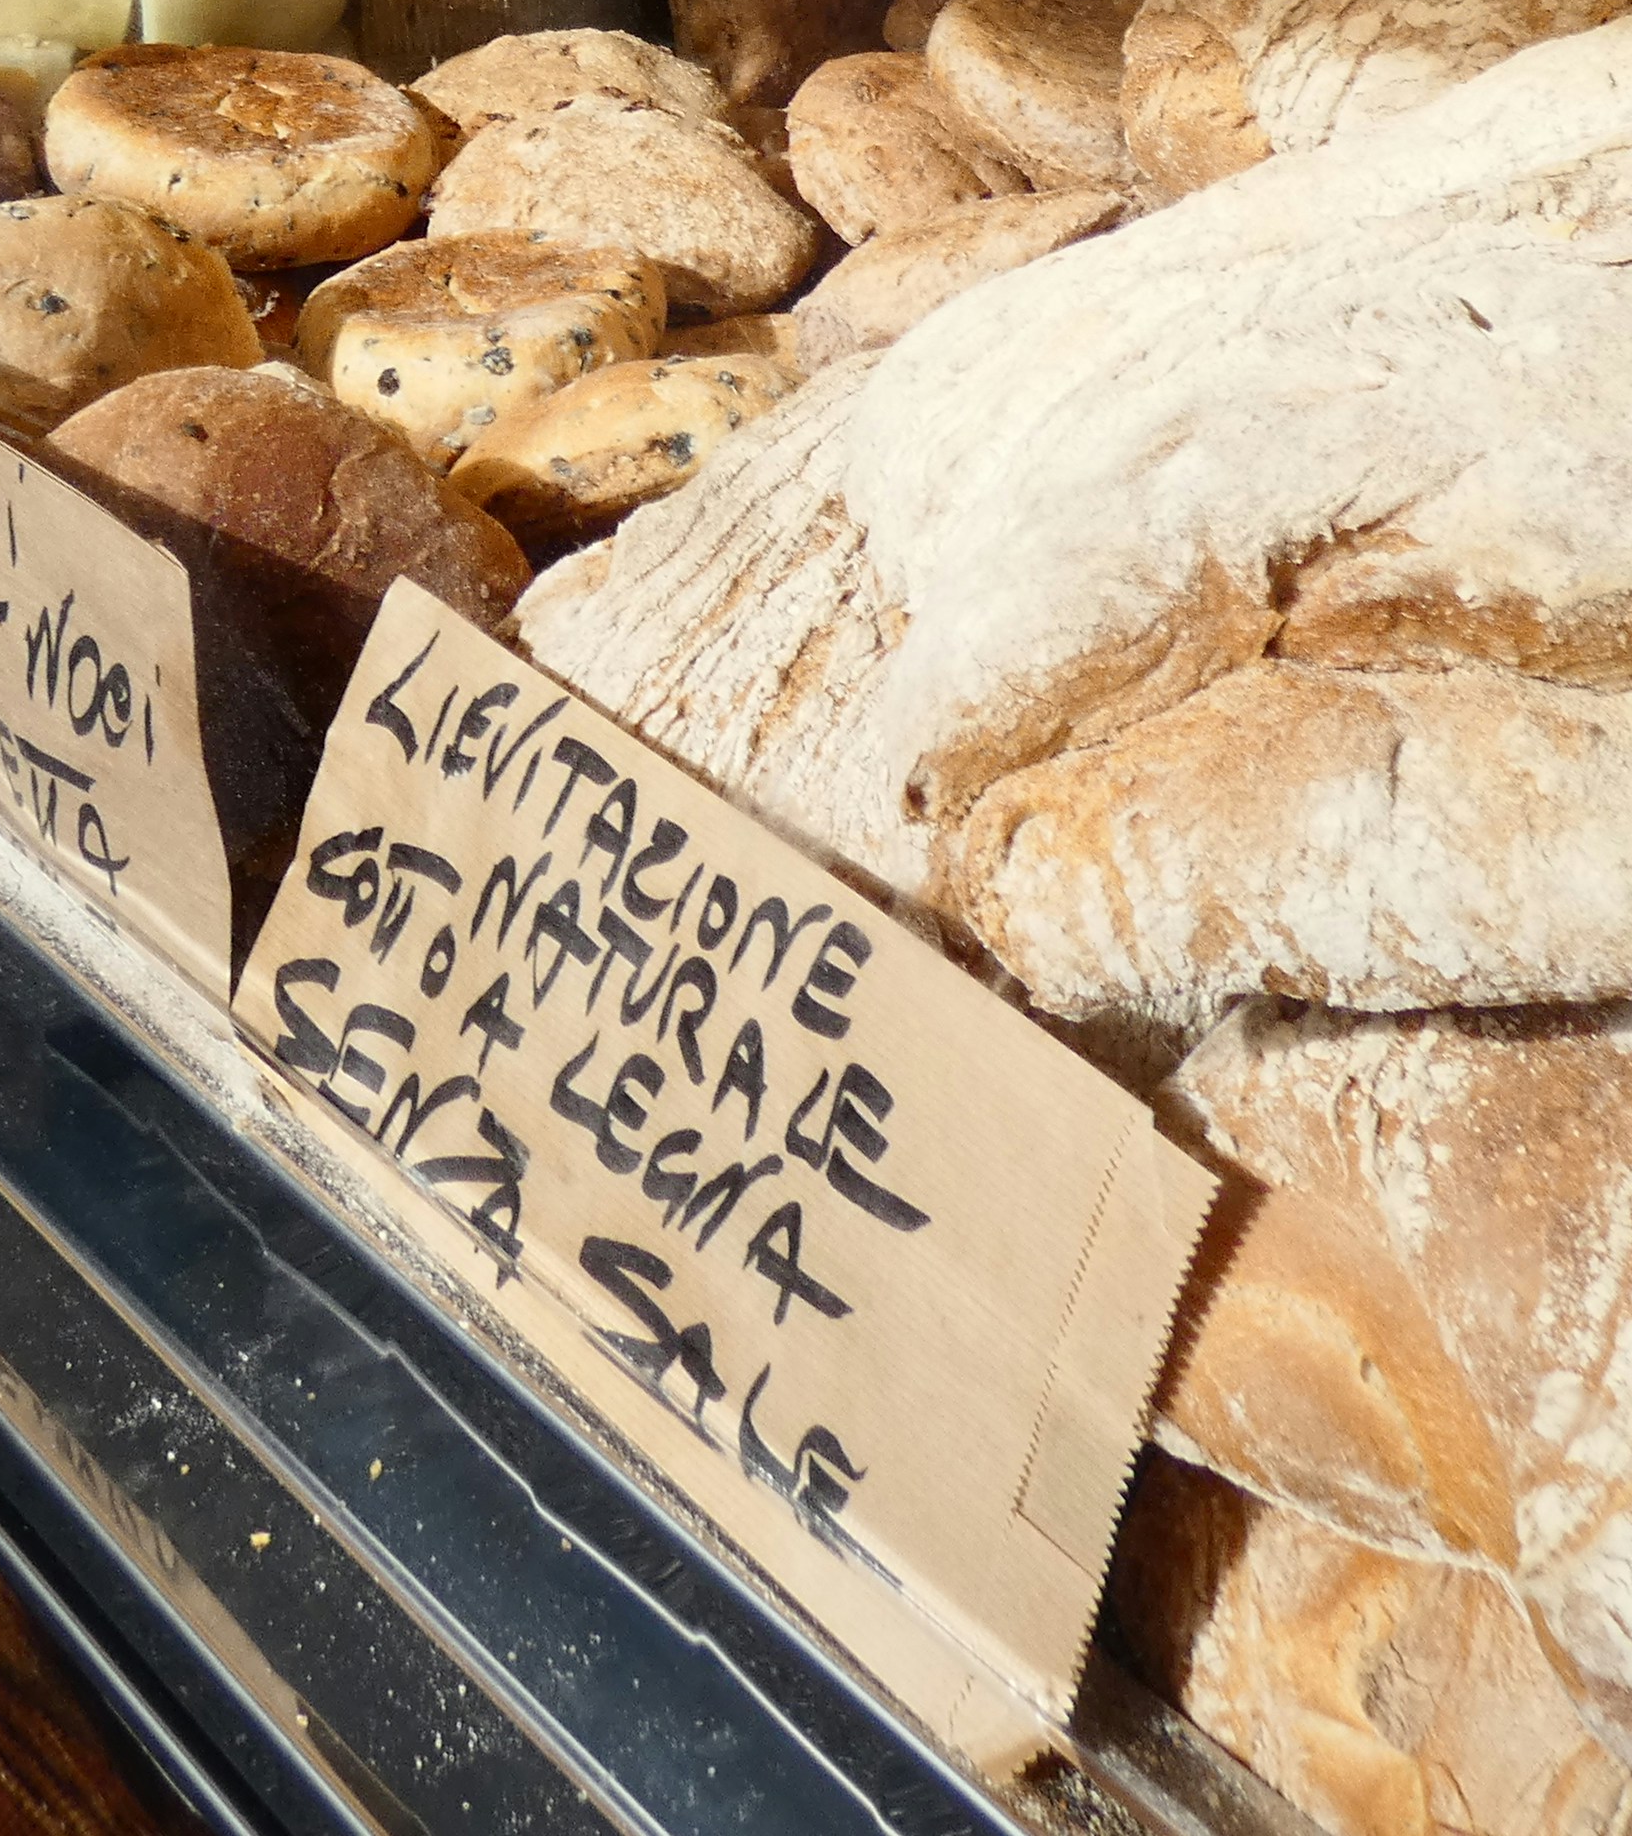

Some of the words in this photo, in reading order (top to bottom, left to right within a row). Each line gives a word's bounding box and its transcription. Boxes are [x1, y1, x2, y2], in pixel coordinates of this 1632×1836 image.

[365, 630, 874, 1041] LIEVITAZIONE
[458, 971, 527, 1078] A
[549, 1029, 856, 1327] LEGNA
[469, 851, 932, 1233] NATURALE
[273, 957, 531, 1290] SENZA
[578, 1235, 888, 1574] SALE
